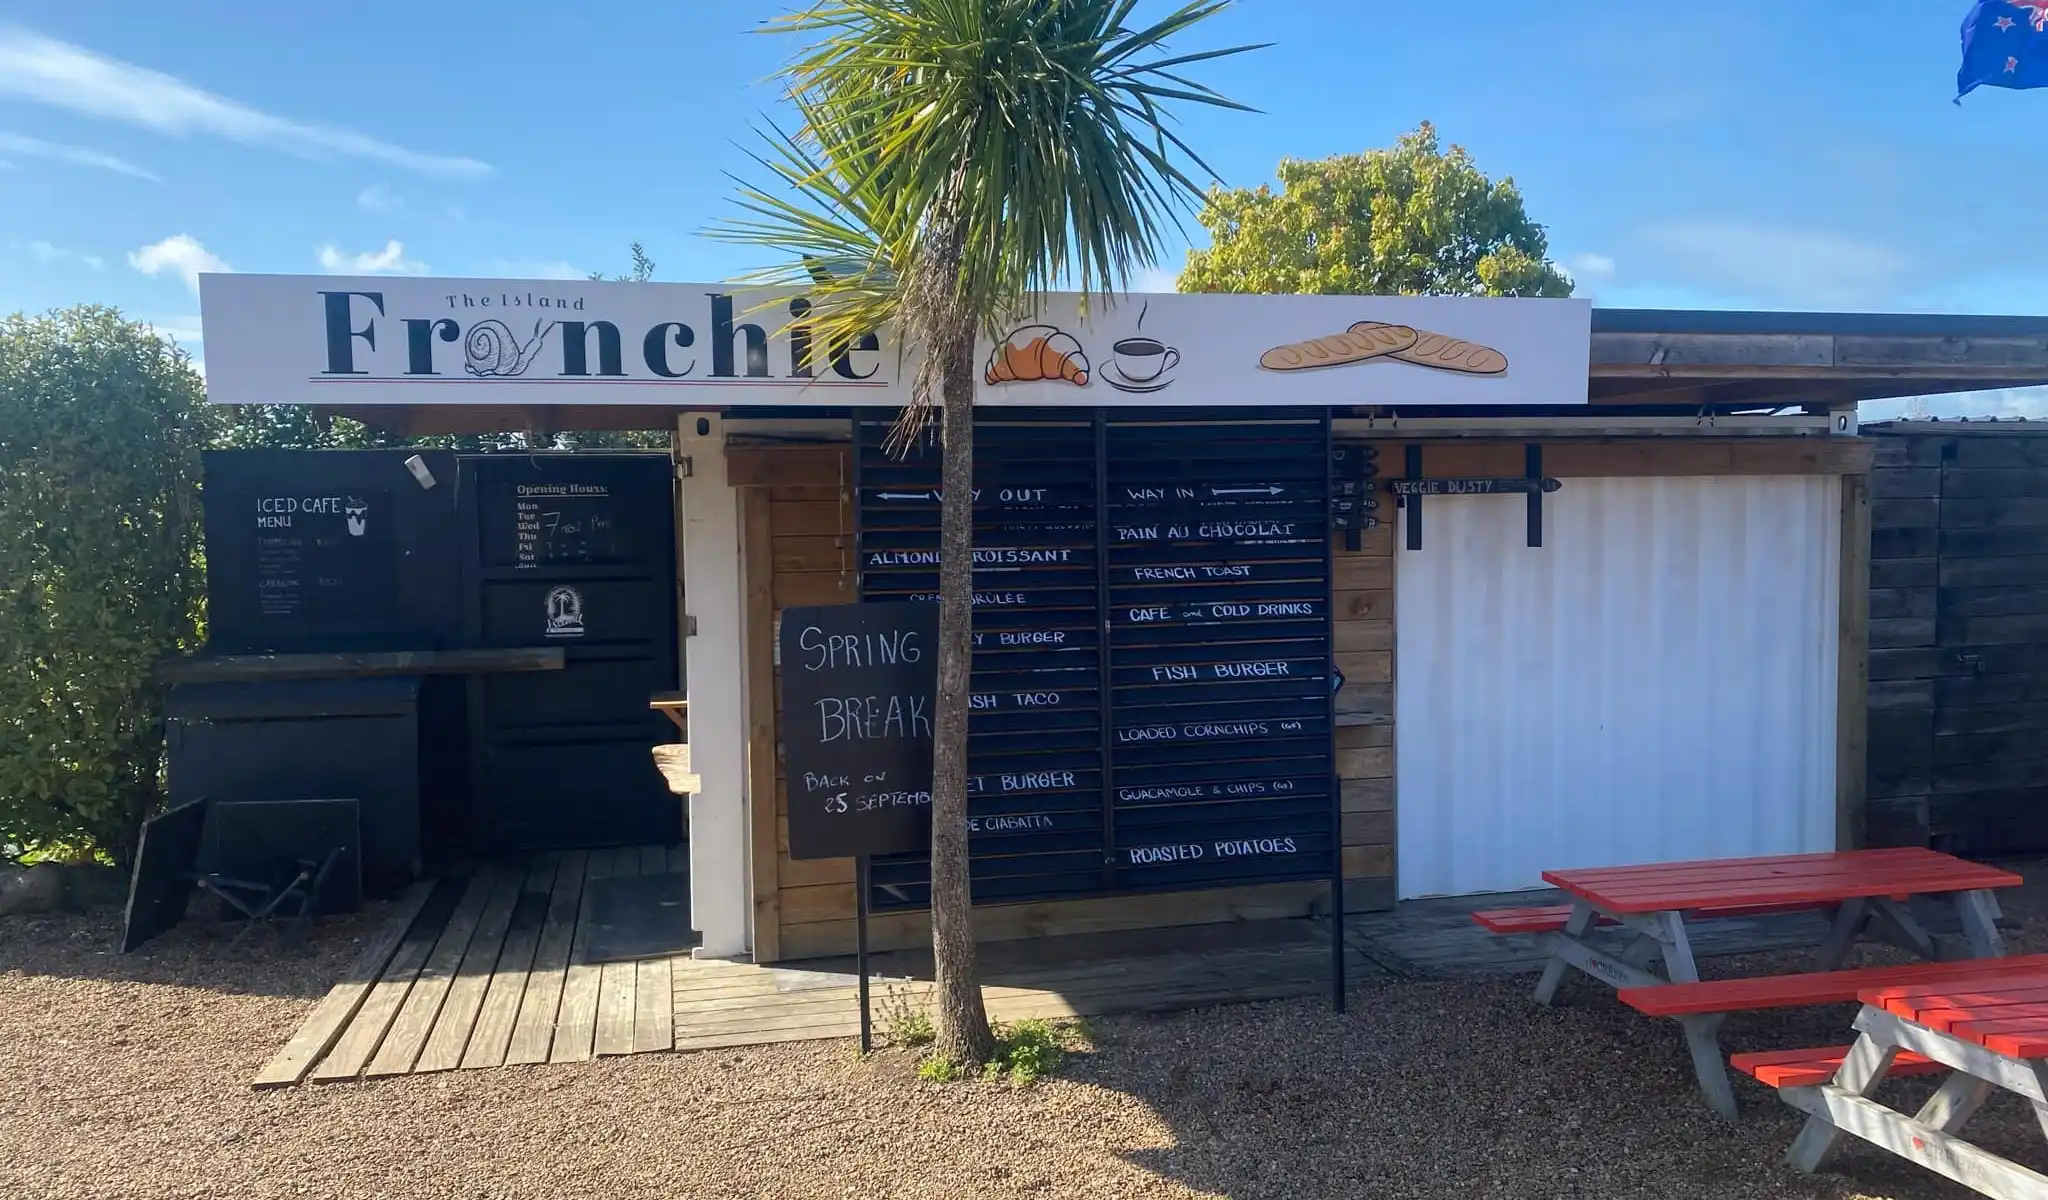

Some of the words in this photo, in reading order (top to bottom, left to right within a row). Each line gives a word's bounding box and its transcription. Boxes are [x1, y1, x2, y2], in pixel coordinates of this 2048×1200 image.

[446, 294, 490, 308] The
[502, 293, 585, 311] Island
[517, 484, 567, 496] Opening
[570, 483, 608, 493] Hours:
[1000, 488, 1047, 502] OUT
[1127, 487, 1165, 501] WAY
[1175, 486, 1195, 499] IN
[1393, 481, 1439, 494] VEGGIE
[1447, 480, 1493, 493] DUSTY
[257, 497, 298, 513] ICED
[302, 497, 341, 514] CAFE
[516, 502, 538, 510] Mon
[257, 515, 292, 528] MENU
[517, 511, 535, 520] Tue
[542, 511, 561, 536] 7
[517, 522, 540, 530] Wed
[1117, 526, 1158, 540] PAIN
[1199, 523, 1296, 538] CHOCOLAT
[517, 532, 537, 540] Thu
[519, 542, 532, 551] Fri
[519, 553, 535, 561] Sat
[972, 548, 1071, 563] ROISSANT
[1134, 566, 1197, 580] FRENCH
[1201, 565, 1251, 577] TOAST
[1129, 606, 1172, 622] CAFE
[1183, 607, 1204, 618] and
[1212, 604, 1251, 618] COLD
[1258, 602, 1313, 616] DRINKS
[1000, 631, 1065, 645] BURGER
[800, 626, 921, 671] SPRING
[1151, 665, 1198, 681] FISH
[1214, 661, 1291, 678] BURGER
[967, 694, 997, 709] ISH
[1012, 692, 1060, 706] TACO
[813, 695, 933, 743] BREAK
[1118, 726, 1177, 742] LOADED
[1183, 722, 1269, 738] CORNCHIPS
[1001, 771, 1076, 791] BURGER
[1119, 786, 1204, 801] GUACAMOLE
[1212, 785, 1221, 795] &
[1227, 782, 1265, 794] CHIPS
[824, 792, 848, 813] 25
[855, 790, 933, 811] SEPTEMB
[985, 815, 1054, 831] CIABATTA
[1129, 844, 1204, 865] ROASTED
[1214, 836, 1297, 857] POTATOES
